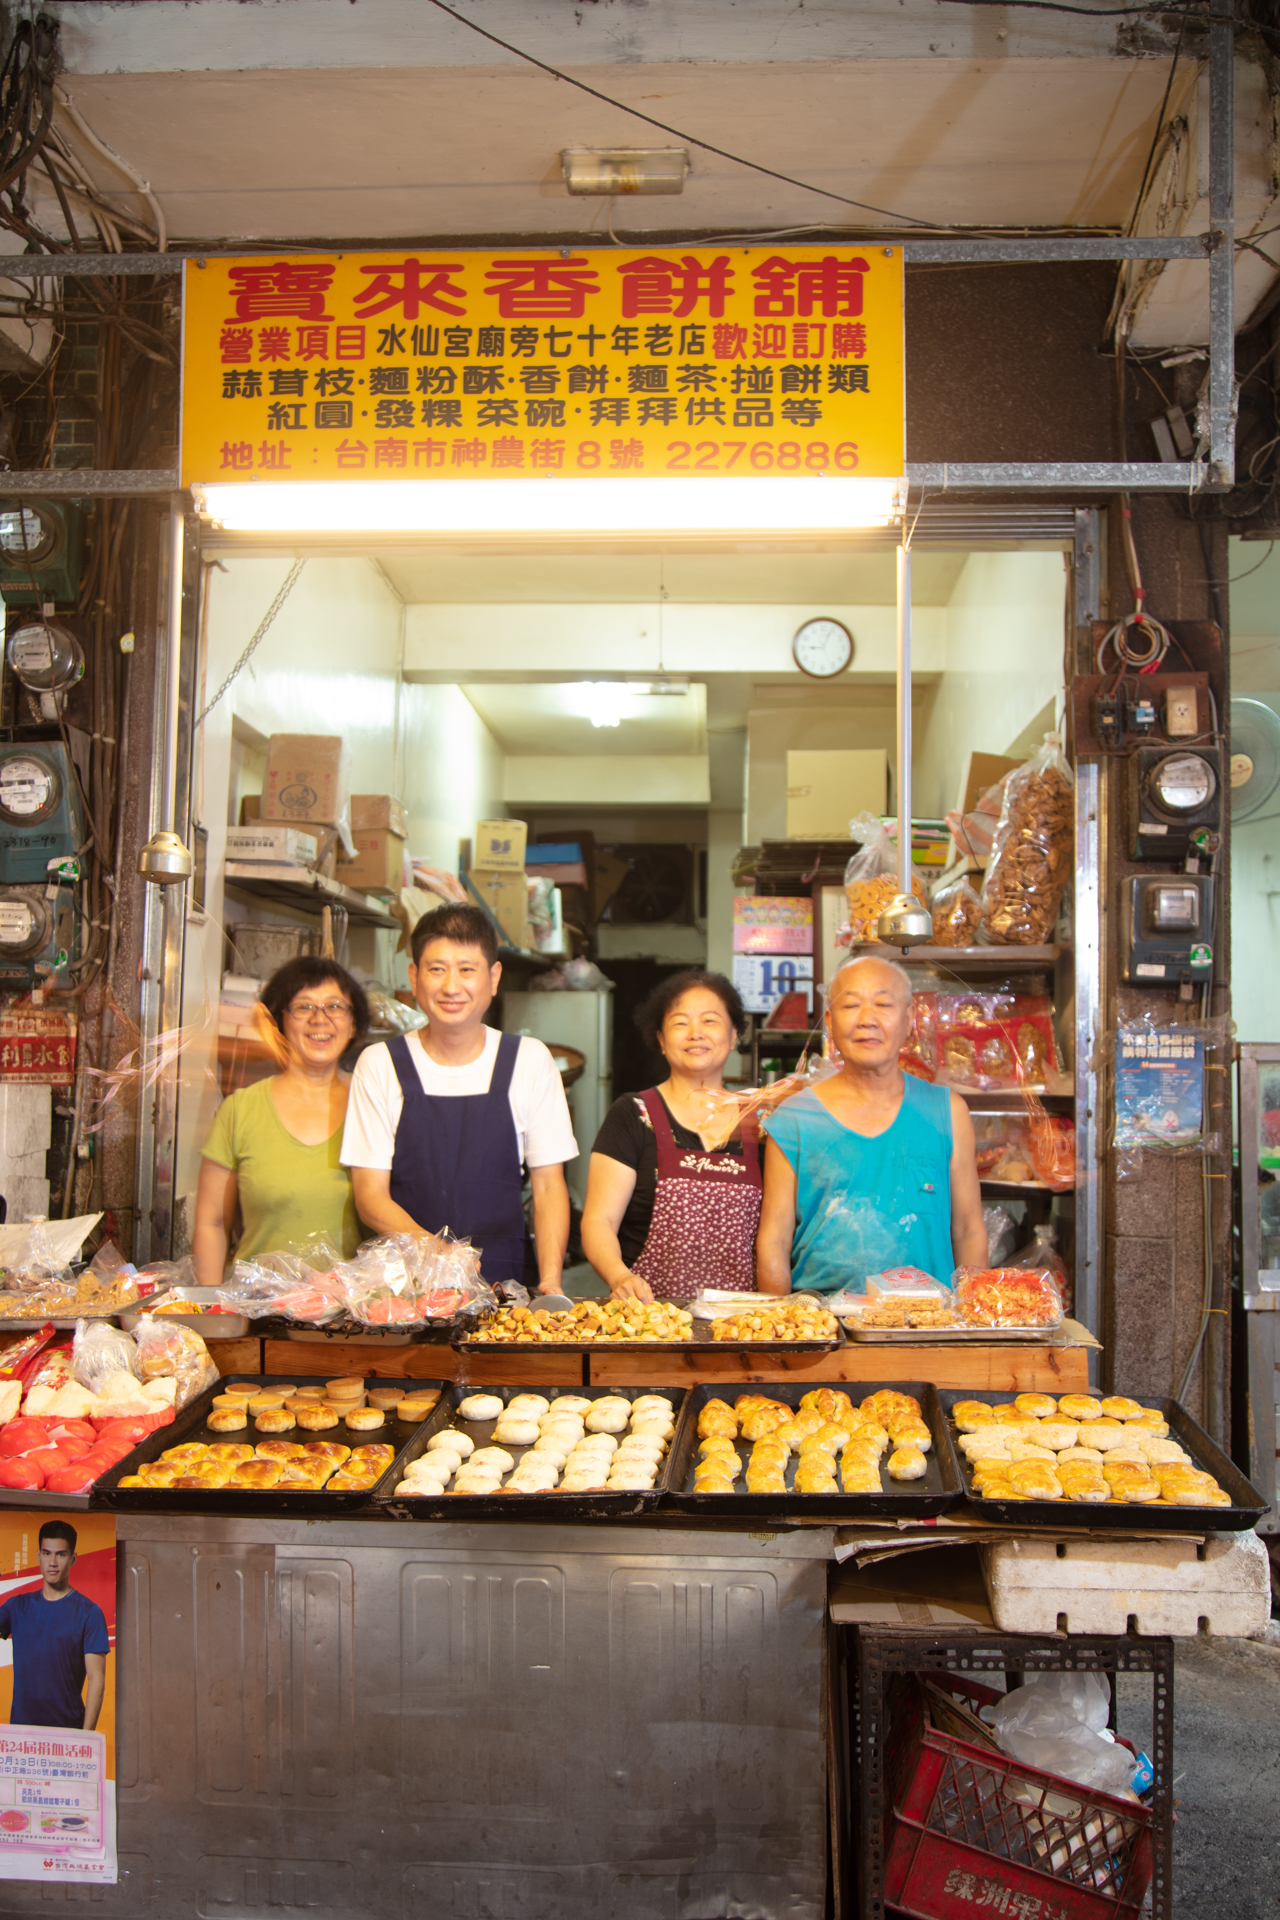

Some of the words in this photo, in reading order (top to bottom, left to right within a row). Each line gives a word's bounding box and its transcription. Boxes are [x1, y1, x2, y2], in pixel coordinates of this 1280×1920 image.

[223, 256, 871, 325] 寶來香餅舖
[219, 325, 366, 364] 營業項目
[376, 322, 707, 358] 水仙宮廟旁七十年老店
[712, 322, 868, 360] 歡迎訂購
[666, 441, 860, 471] 2276886
